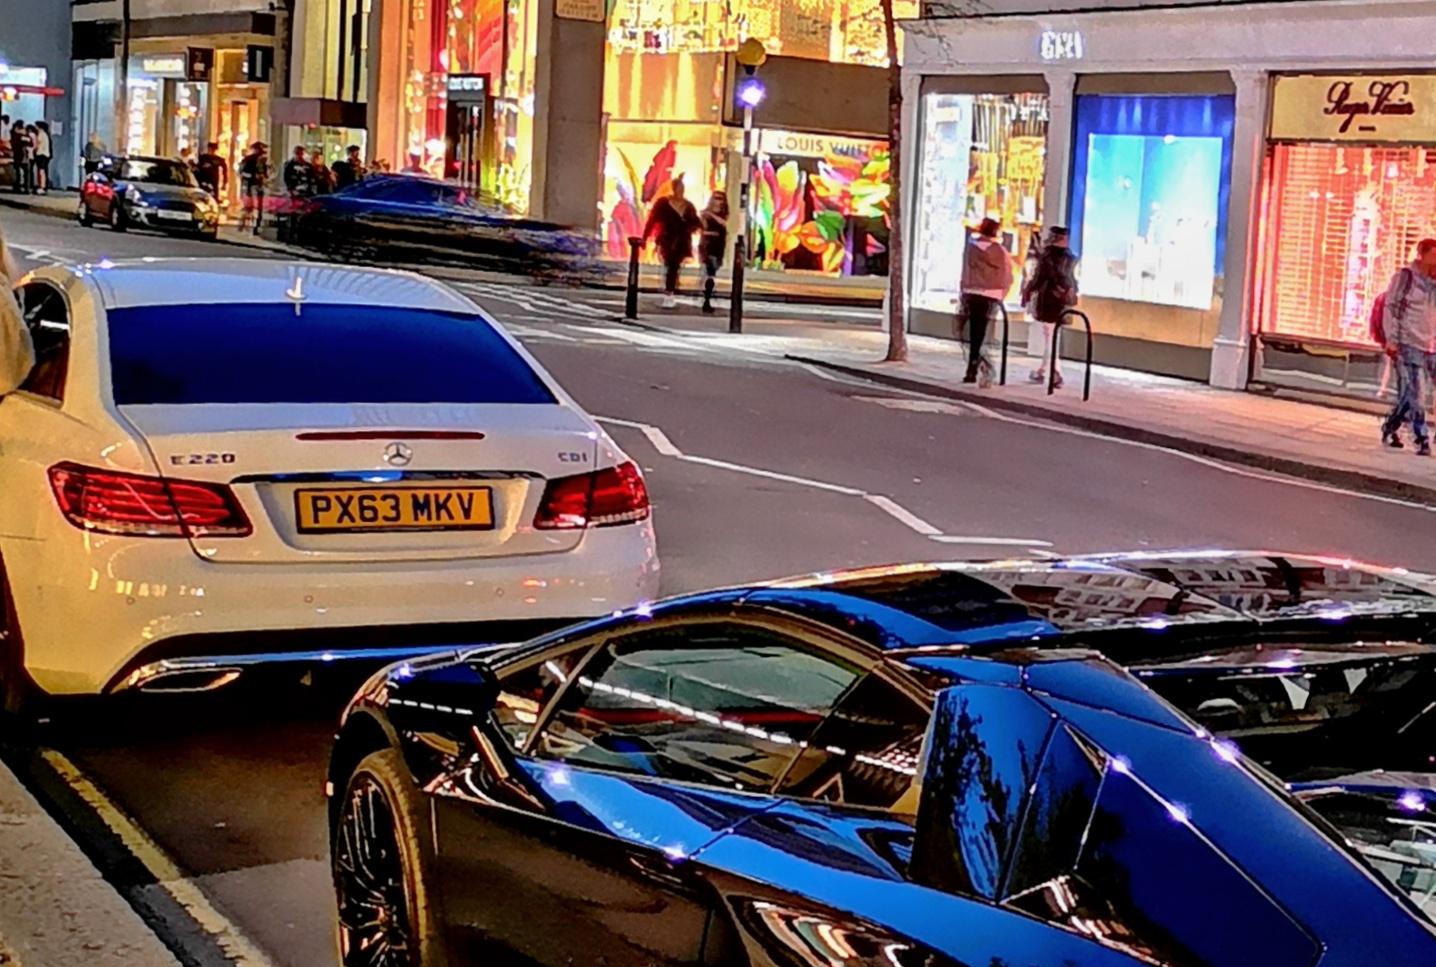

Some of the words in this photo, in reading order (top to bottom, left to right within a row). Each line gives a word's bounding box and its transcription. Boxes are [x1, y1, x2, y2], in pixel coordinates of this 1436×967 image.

[778, 136, 824, 152] LOUIS
[828, 141, 889, 160] VUITTO
[557, 452, 588, 463] CDI
[311, 494, 401, 525] PX63
[411, 491, 475, 523] MKV
